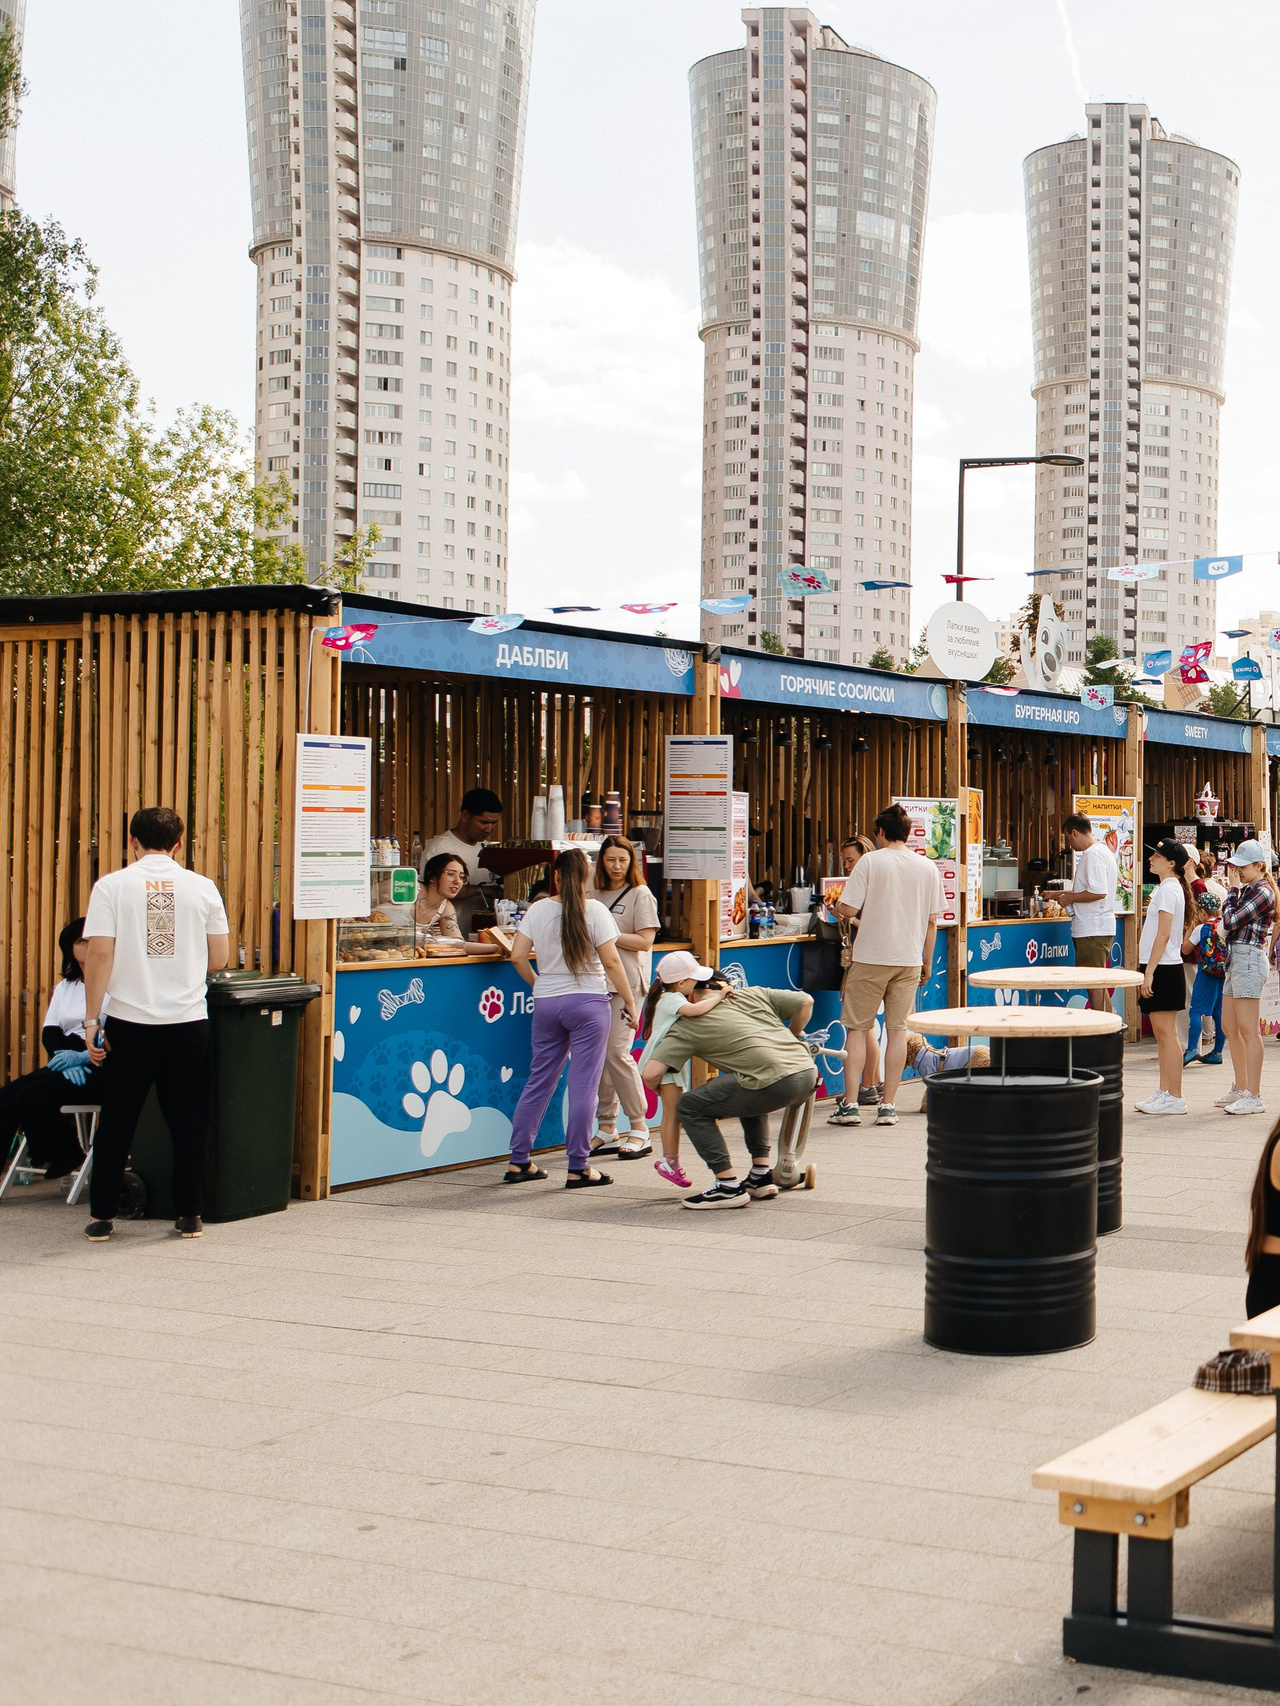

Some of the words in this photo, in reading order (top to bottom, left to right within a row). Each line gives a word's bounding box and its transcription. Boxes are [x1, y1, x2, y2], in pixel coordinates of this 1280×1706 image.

[1212, 564, 1226, 572] VK
[946, 620, 964, 632] Лапки
[964, 625, 981, 636] вверх
[947, 635, 954, 643] за
[954, 636, 980, 647] любимые
[496, 643, 569, 671] ДАБЛБИ
[948, 648, 979, 660] вкусняшки!
[1154, 659, 1170, 669] Лапки
[780, 674, 836, 697] ГОРЯЧИЕ
[838, 681, 895, 703] СОСИСКИ
[1015, 704, 1062, 723] БУРГЕРНАЯ
[1063, 711, 1080, 725] UFO
[1184, 724, 1209, 739] SWEETY
[145, 880, 175, 892] NE
[394, 880, 414, 888] Delivery
[1040, 942, 1069, 959] Лапки
